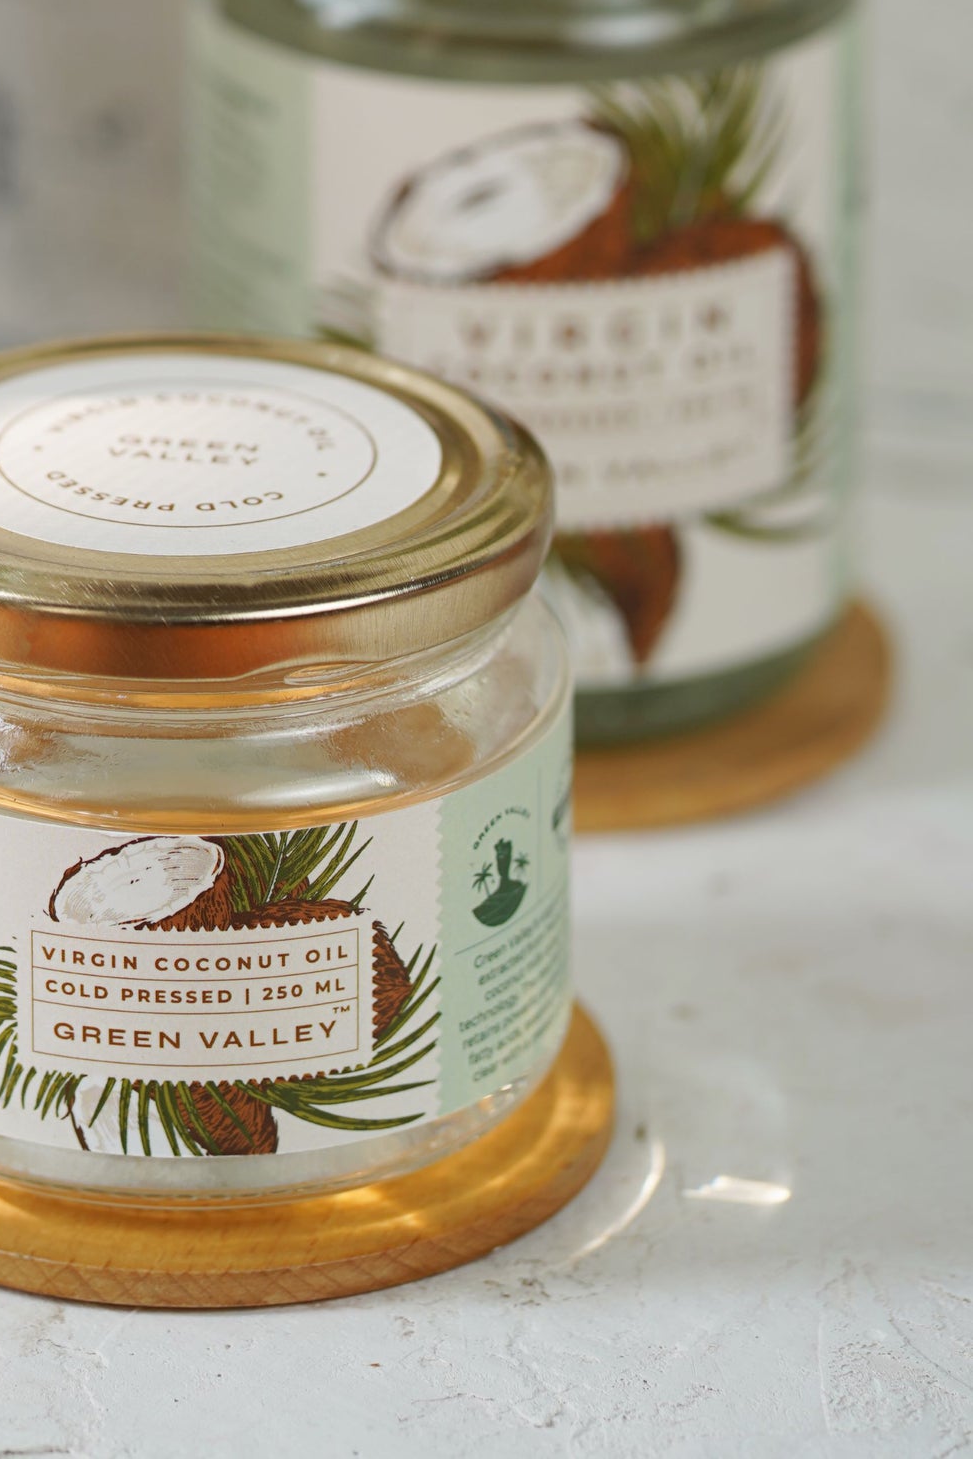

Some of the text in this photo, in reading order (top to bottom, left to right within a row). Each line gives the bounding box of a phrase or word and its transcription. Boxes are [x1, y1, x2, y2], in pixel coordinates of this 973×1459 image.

[453, 300, 731, 354] VIRGIN
[108, 445, 258, 465] VALLEY
[118, 433, 259, 452] GREEN
[46, 470, 284, 512] COLD PRESSED
[41, 945, 348, 971] VIRGIN COCONUT OIL
[45, 979, 109, 999] COLD
[121, 988, 233, 1004] PRESSED
[262, 984, 303, 1001] 250
[315, 978, 345, 995] ML
[53, 1022, 181, 1049] GREEN
[198, 1020, 337, 1049] VALLEY
